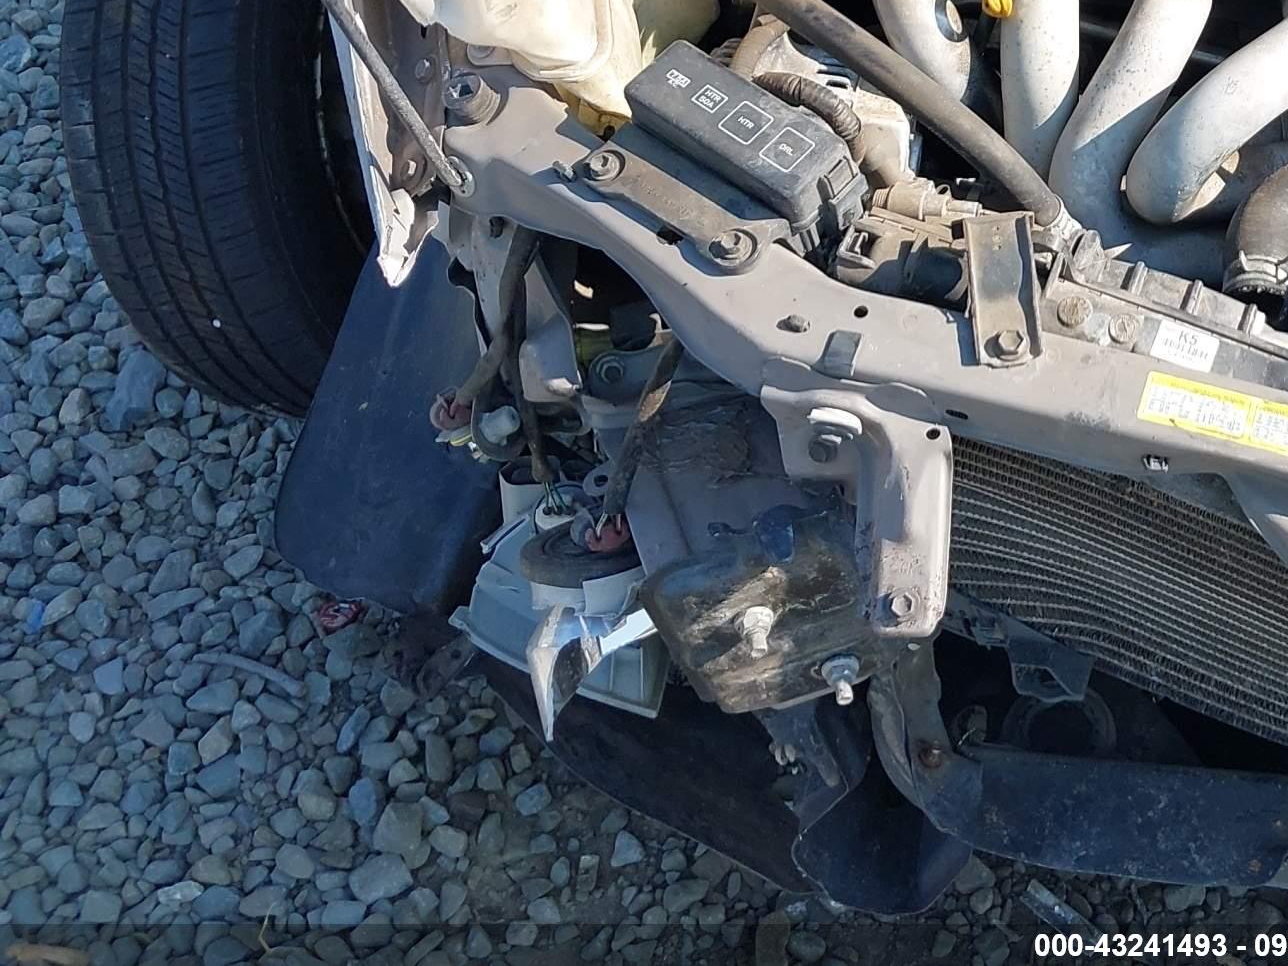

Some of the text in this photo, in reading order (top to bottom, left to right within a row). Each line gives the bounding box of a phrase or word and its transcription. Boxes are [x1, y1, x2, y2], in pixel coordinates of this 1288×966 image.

[704, 89, 722, 103] HTR
[737, 115, 755, 130] HTR
[778, 143, 795, 157] DRL
